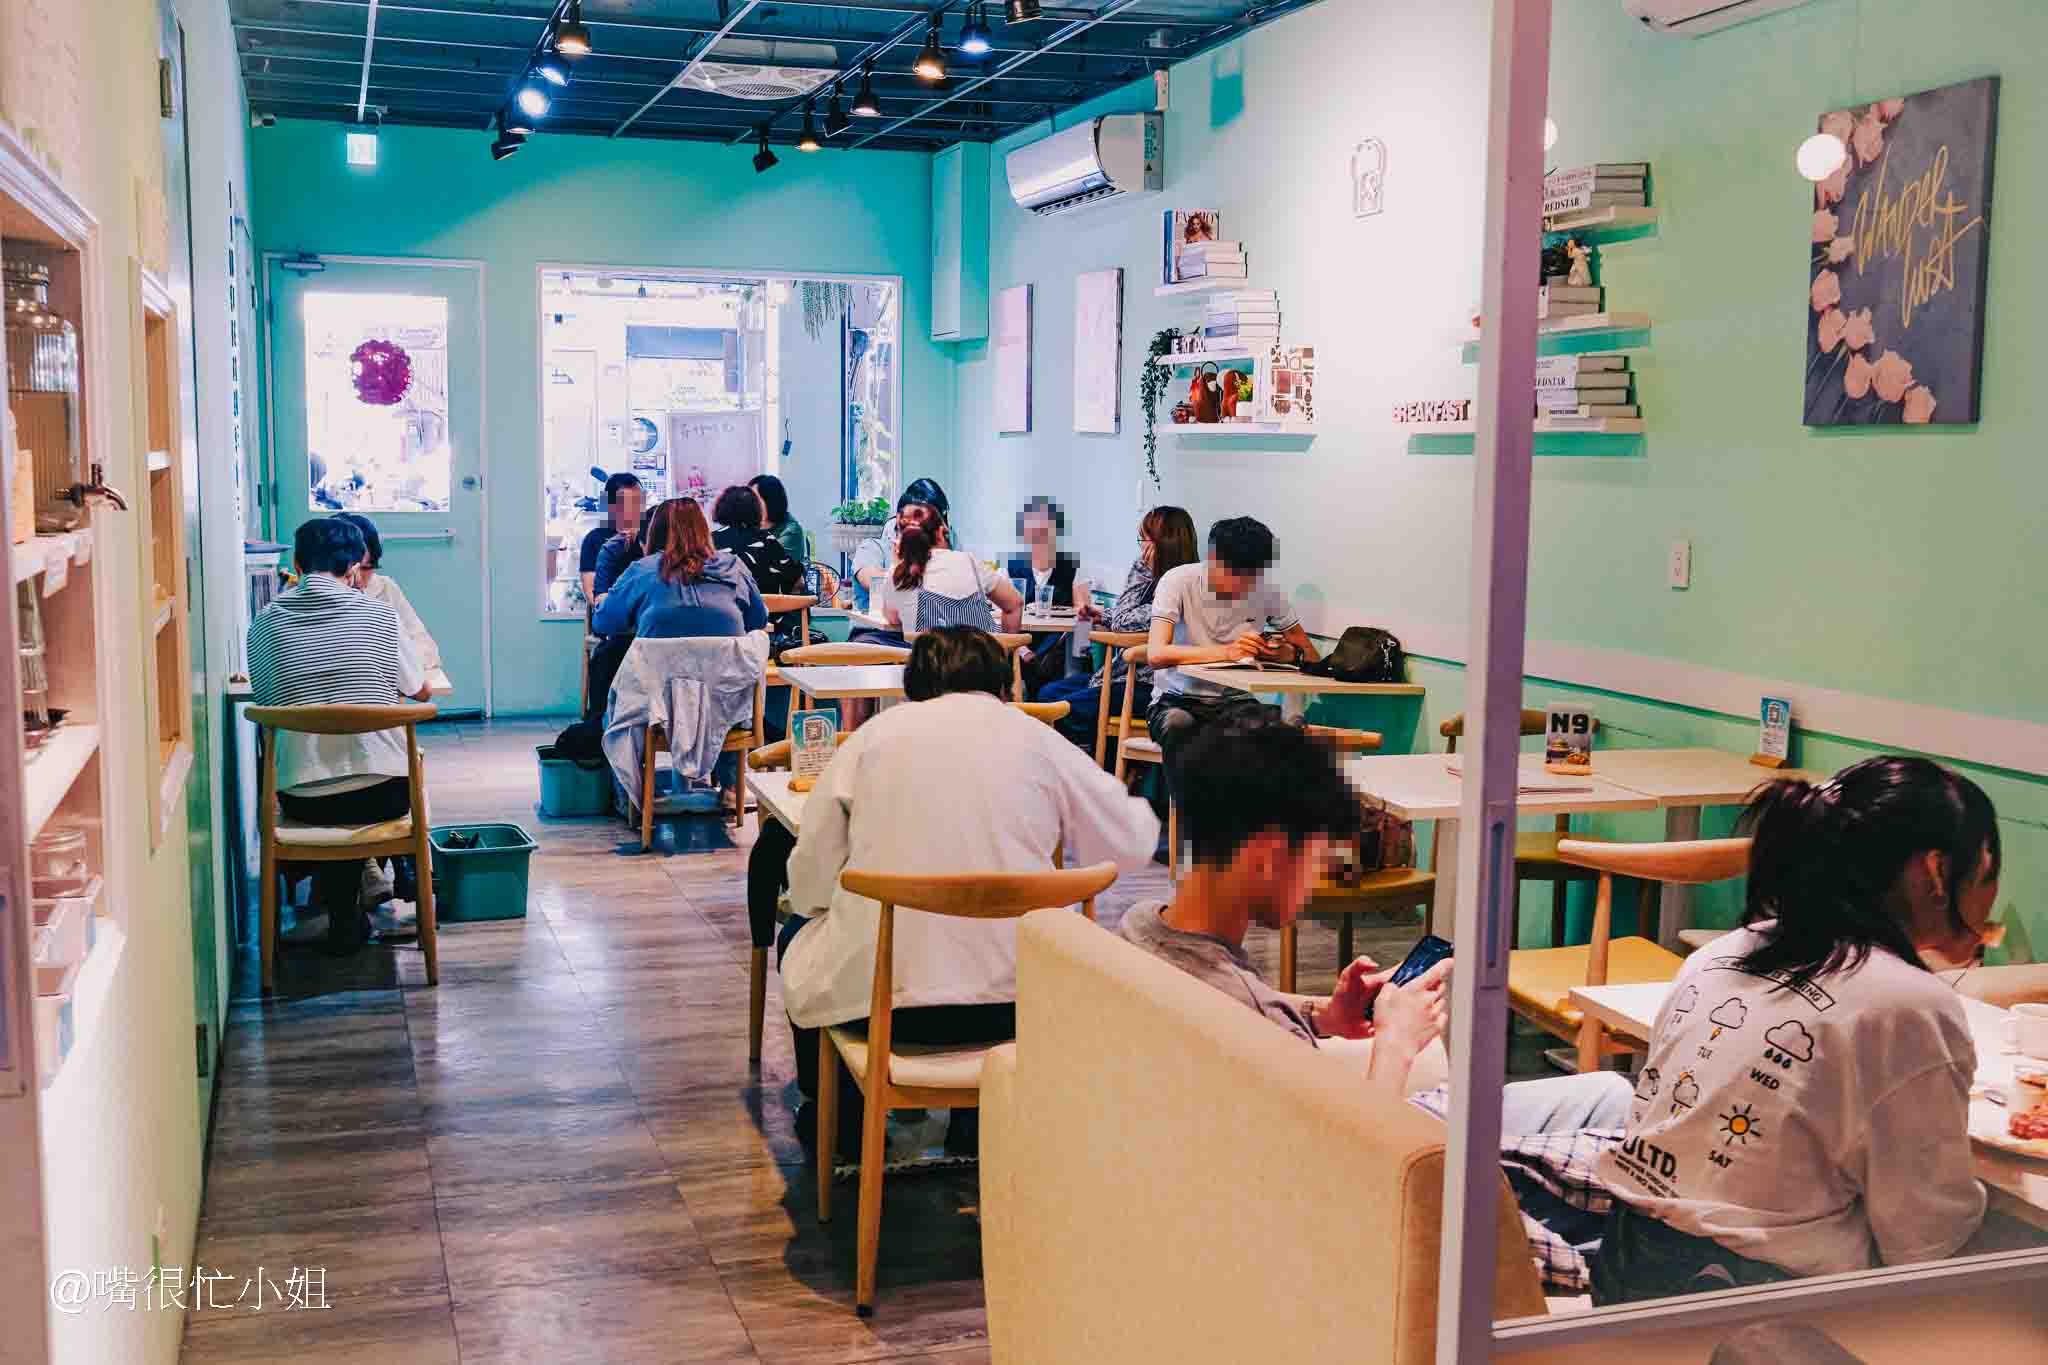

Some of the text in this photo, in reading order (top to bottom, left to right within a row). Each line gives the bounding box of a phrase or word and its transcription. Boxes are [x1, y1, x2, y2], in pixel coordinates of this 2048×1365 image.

[1537, 376, 1566, 387] EDSTAR
[1551, 713, 1589, 735] N9
[1750, 1067, 1780, 1090] WED
